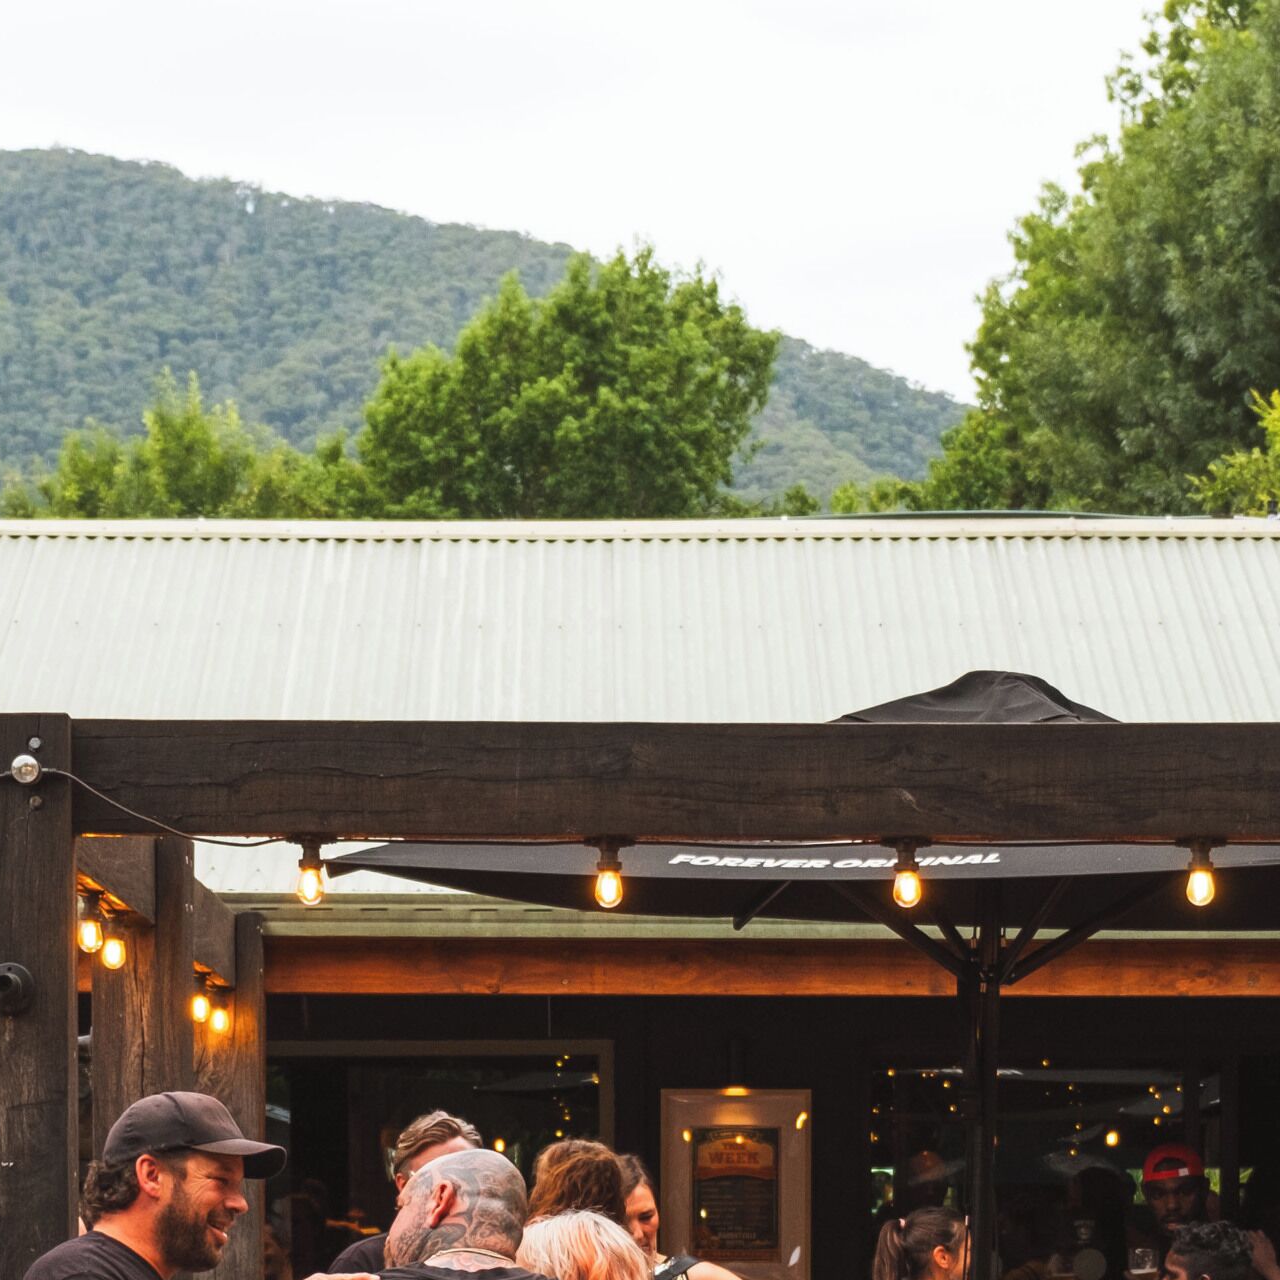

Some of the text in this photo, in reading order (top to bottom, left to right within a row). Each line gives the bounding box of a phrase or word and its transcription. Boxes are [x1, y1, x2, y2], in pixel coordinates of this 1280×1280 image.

[668, 853, 1001, 869] FOREVER ORIINAL
[708, 1151, 760, 1164] WEEK
